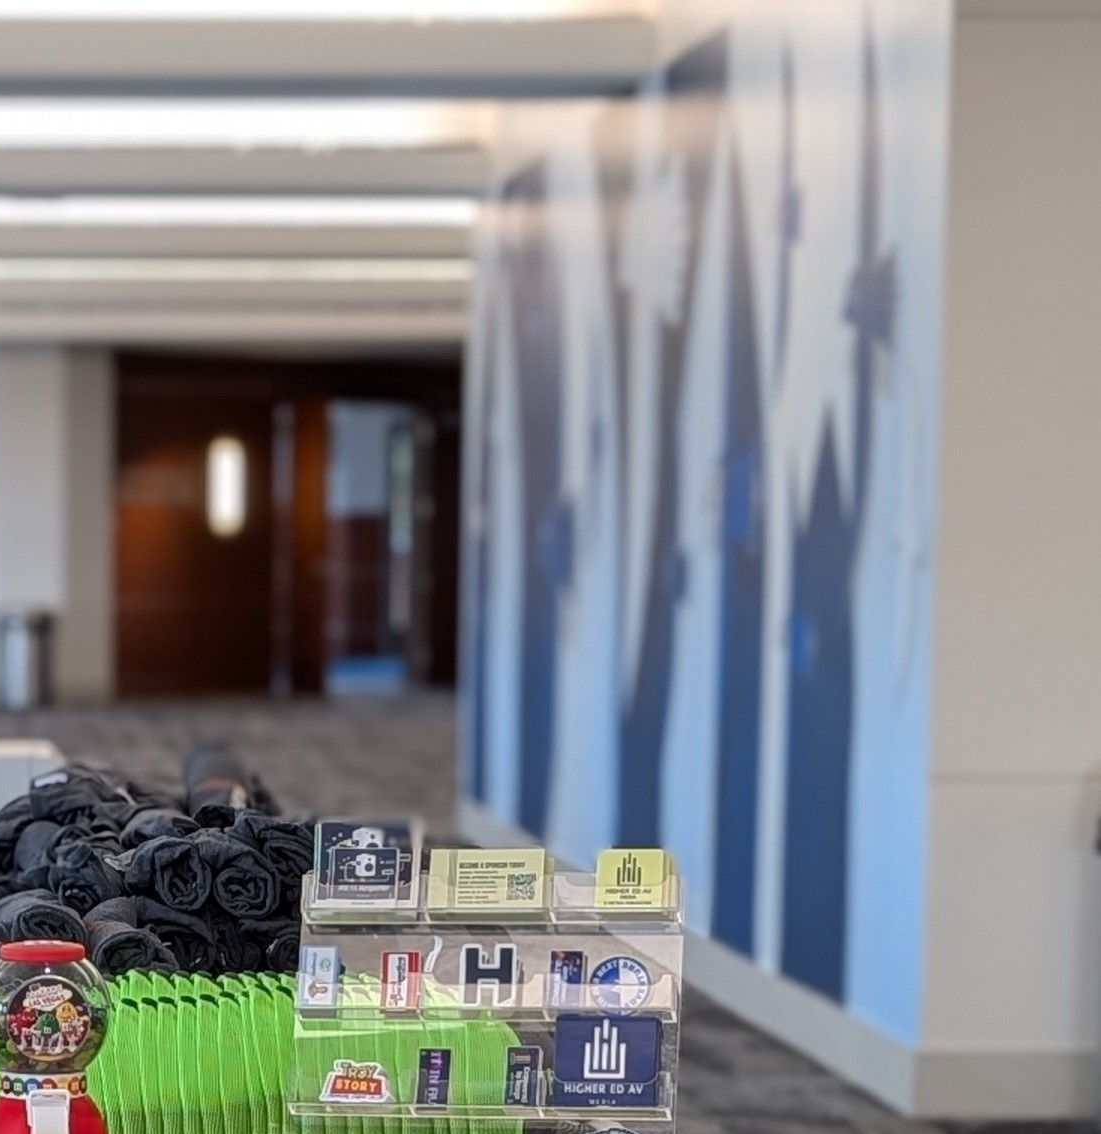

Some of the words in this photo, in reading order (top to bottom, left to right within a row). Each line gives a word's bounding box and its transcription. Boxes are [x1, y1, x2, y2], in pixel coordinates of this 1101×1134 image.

[465, 946, 514, 1006] H
[341, 1062, 376, 1079] TROY
[334, 1078, 378, 1092] STORY
[563, 1083, 606, 1094] HIGHER
[609, 1083, 625, 1094] ED
[628, 1084, 644, 1094] AV
